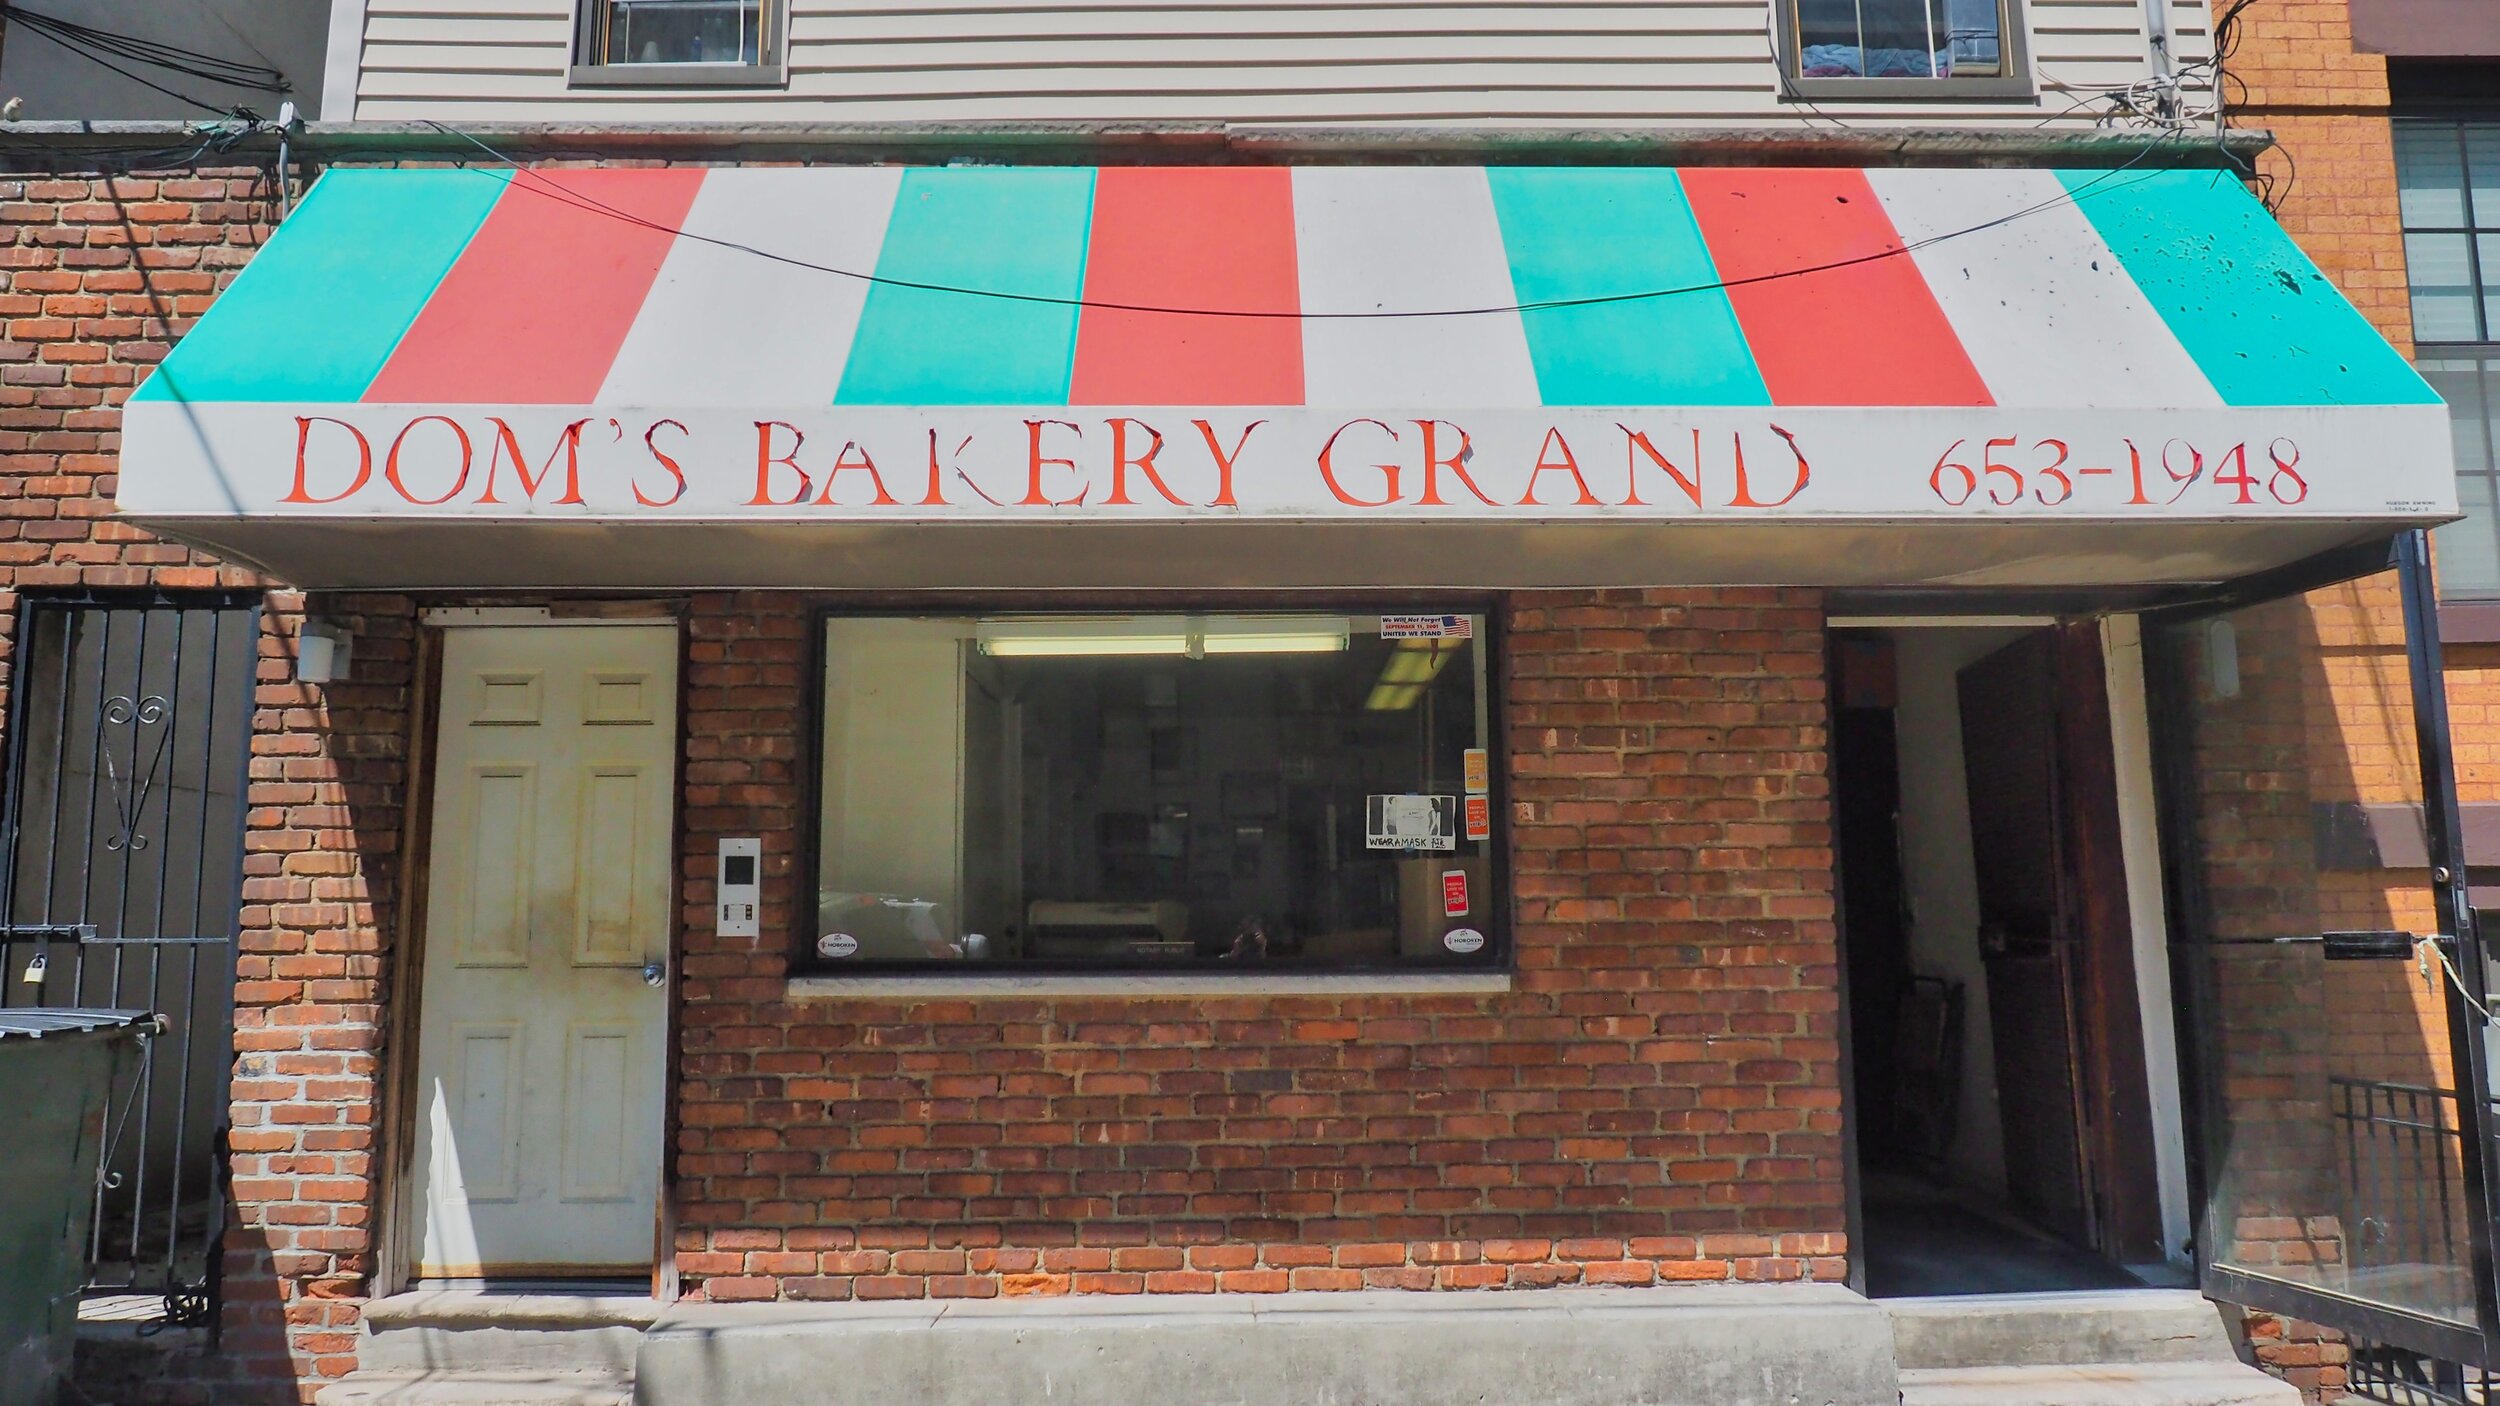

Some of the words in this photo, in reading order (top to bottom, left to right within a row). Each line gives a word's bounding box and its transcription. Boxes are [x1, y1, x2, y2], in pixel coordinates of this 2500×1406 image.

[277, 415, 690, 508] DOM'S
[741, 418, 1269, 509] BAKERY
[1317, 417, 1810, 510] GRAND
[1929, 433, 2308, 507] 653-1948
[1393, 616, 1406, 624] Will
[1369, 838, 1394, 847] WEAR
[1401, 838, 1427, 847] MASK
